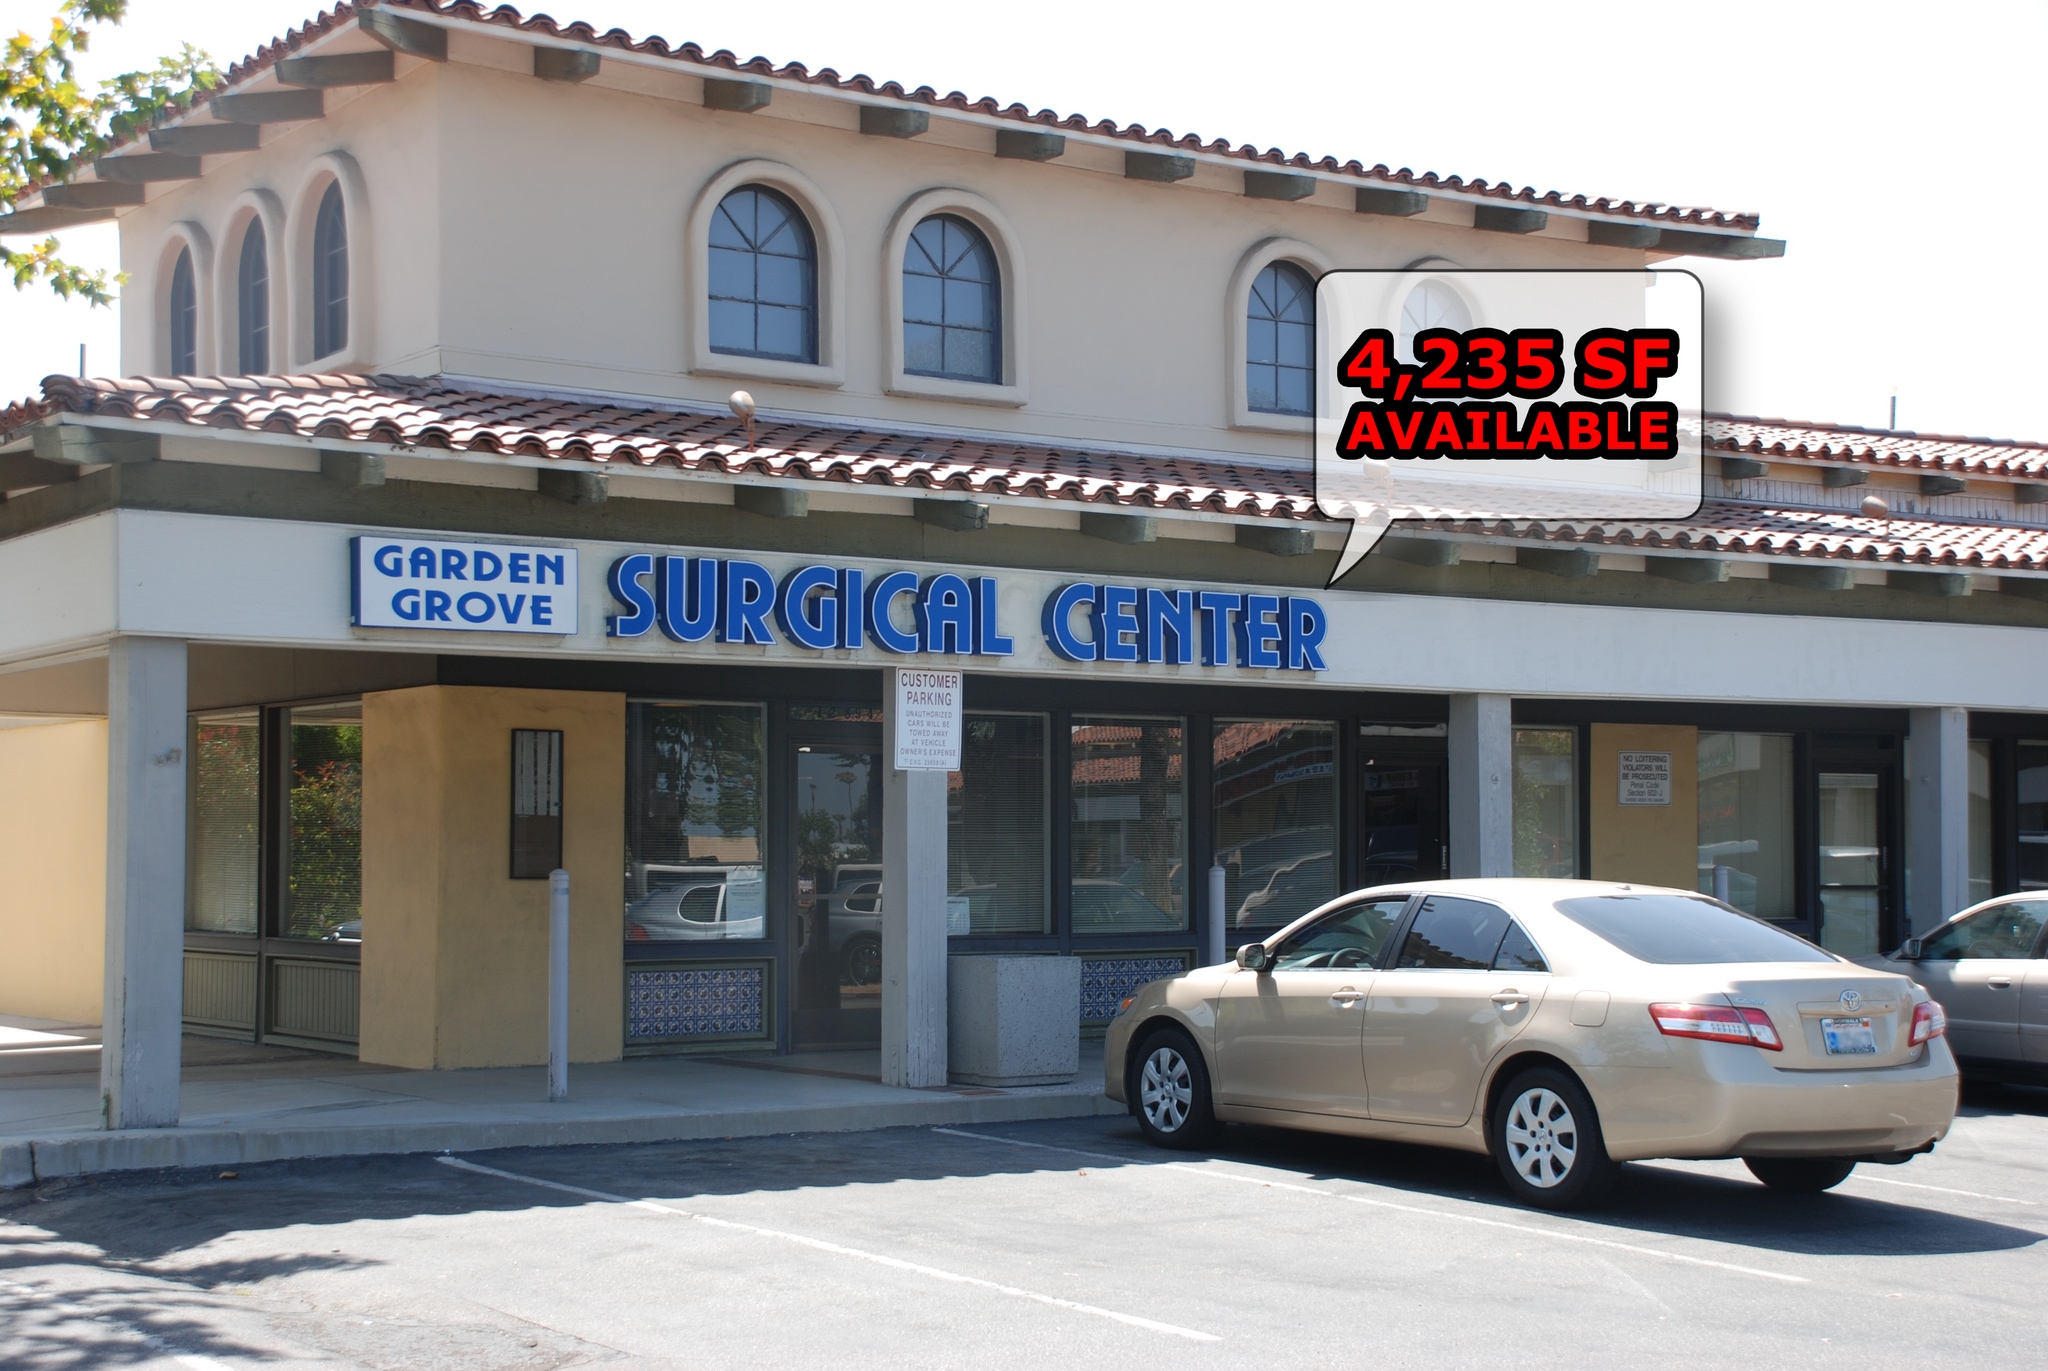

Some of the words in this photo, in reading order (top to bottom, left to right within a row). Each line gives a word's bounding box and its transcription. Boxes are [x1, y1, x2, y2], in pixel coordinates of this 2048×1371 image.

[373, 544, 565, 586] GARDEN
[391, 588, 554, 626] GROVE
[607, 553, 1014, 656] SURGICAL
[1041, 582, 1329, 671] CENTER
[901, 672, 958, 689] CUSTOMER
[906, 691, 952, 706] PARKING
[905, 710, 952, 718] UNAUTHORIZED
[907, 719, 924, 727] CARS
[926, 720, 940, 728] WILL
[909, 729, 931, 737] TOWED
[911, 738, 919, 746] AT
[920, 739, 946, 747] VEHICLE
[900, 748, 927, 756] OWNER'S
[929, 748, 956, 756] EXPENSE
[1635, 755, 1667, 763] LOITERING
[1646, 781, 1659, 789] Code
